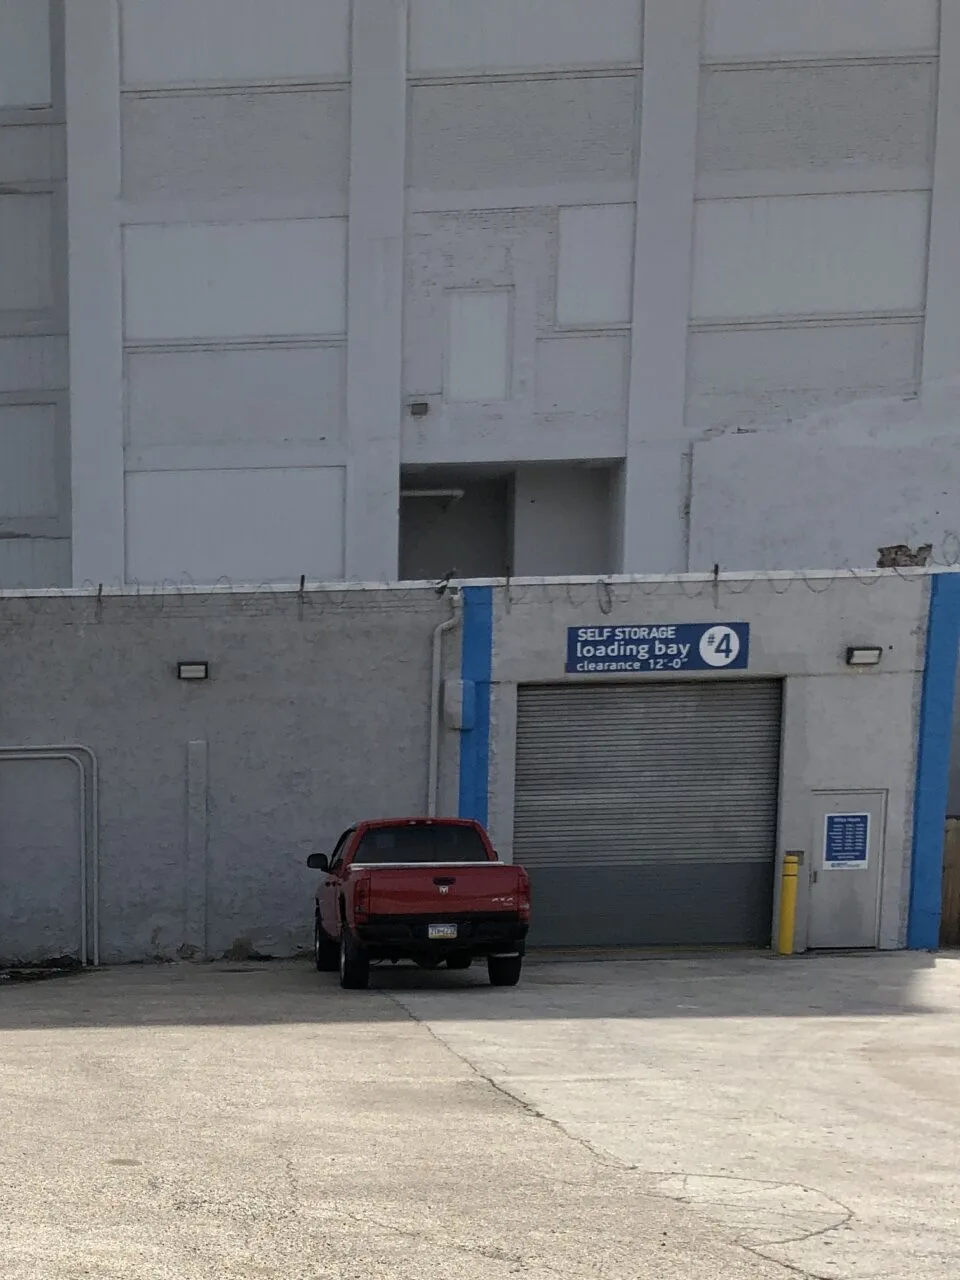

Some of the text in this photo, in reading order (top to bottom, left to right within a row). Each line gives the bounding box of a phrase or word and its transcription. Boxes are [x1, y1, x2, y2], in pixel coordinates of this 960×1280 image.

[577, 626, 677, 641] SELF STORAGE
[576, 640, 690, 659] loading bay
[576, 660, 641, 671] clearance
